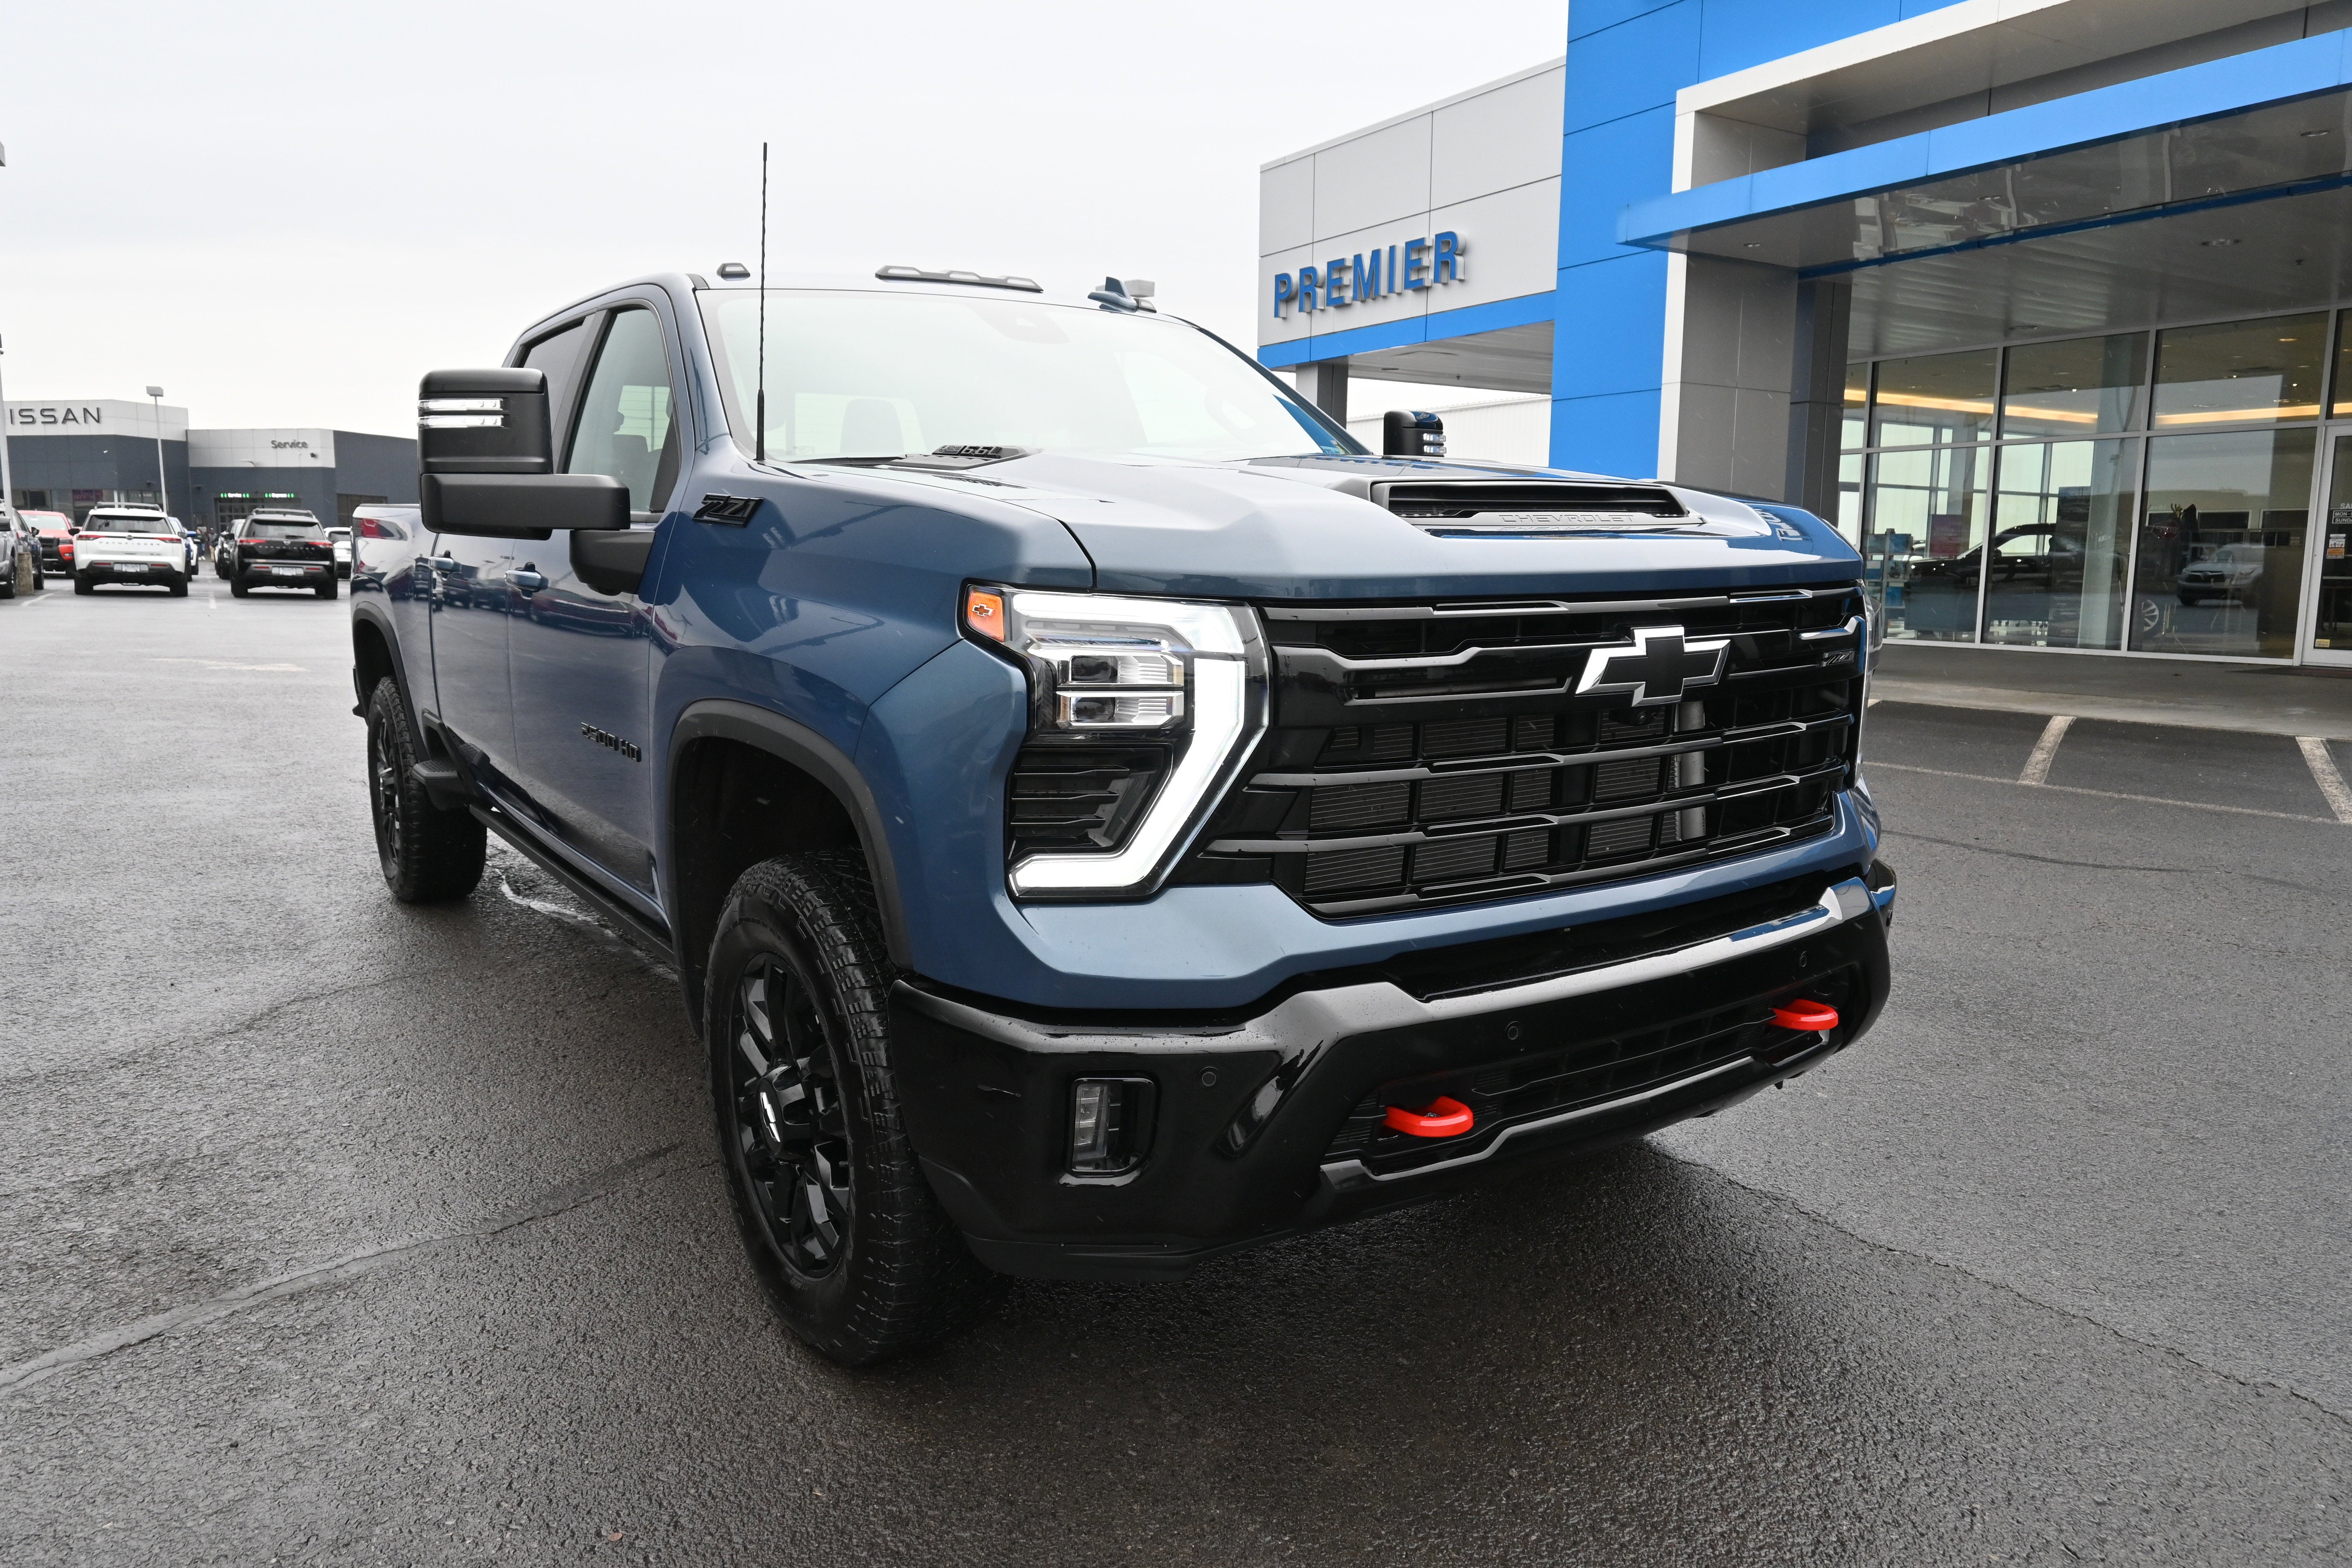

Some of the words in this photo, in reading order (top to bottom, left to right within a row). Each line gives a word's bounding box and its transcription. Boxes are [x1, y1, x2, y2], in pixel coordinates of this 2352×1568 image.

[1274, 231, 1466, 318] PREMIER
[9, 407, 101, 425] ISSAN
[271, 440, 308, 449] Service
[693, 493, 763, 528] Z71
[1499, 514, 1634, 523] CHEVROLET
